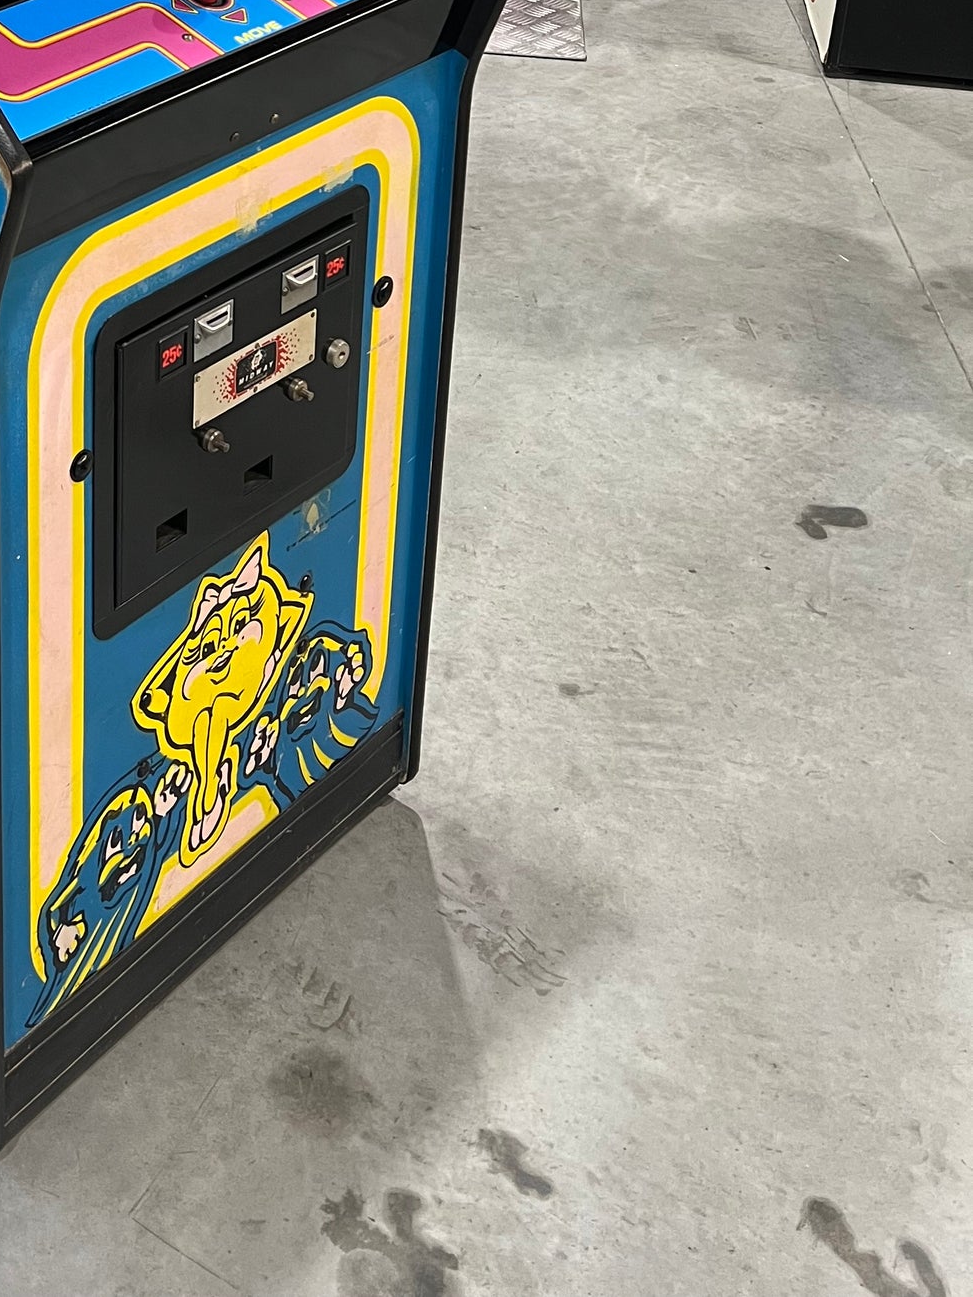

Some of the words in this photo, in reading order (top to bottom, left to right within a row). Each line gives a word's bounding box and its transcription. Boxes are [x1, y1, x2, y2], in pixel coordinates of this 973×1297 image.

[234, 20, 284, 45] MOVE
[326, 255, 346, 278] 25¢
[162, 343, 183, 369] 25¢
[238, 361, 275, 386] MIDWAY
